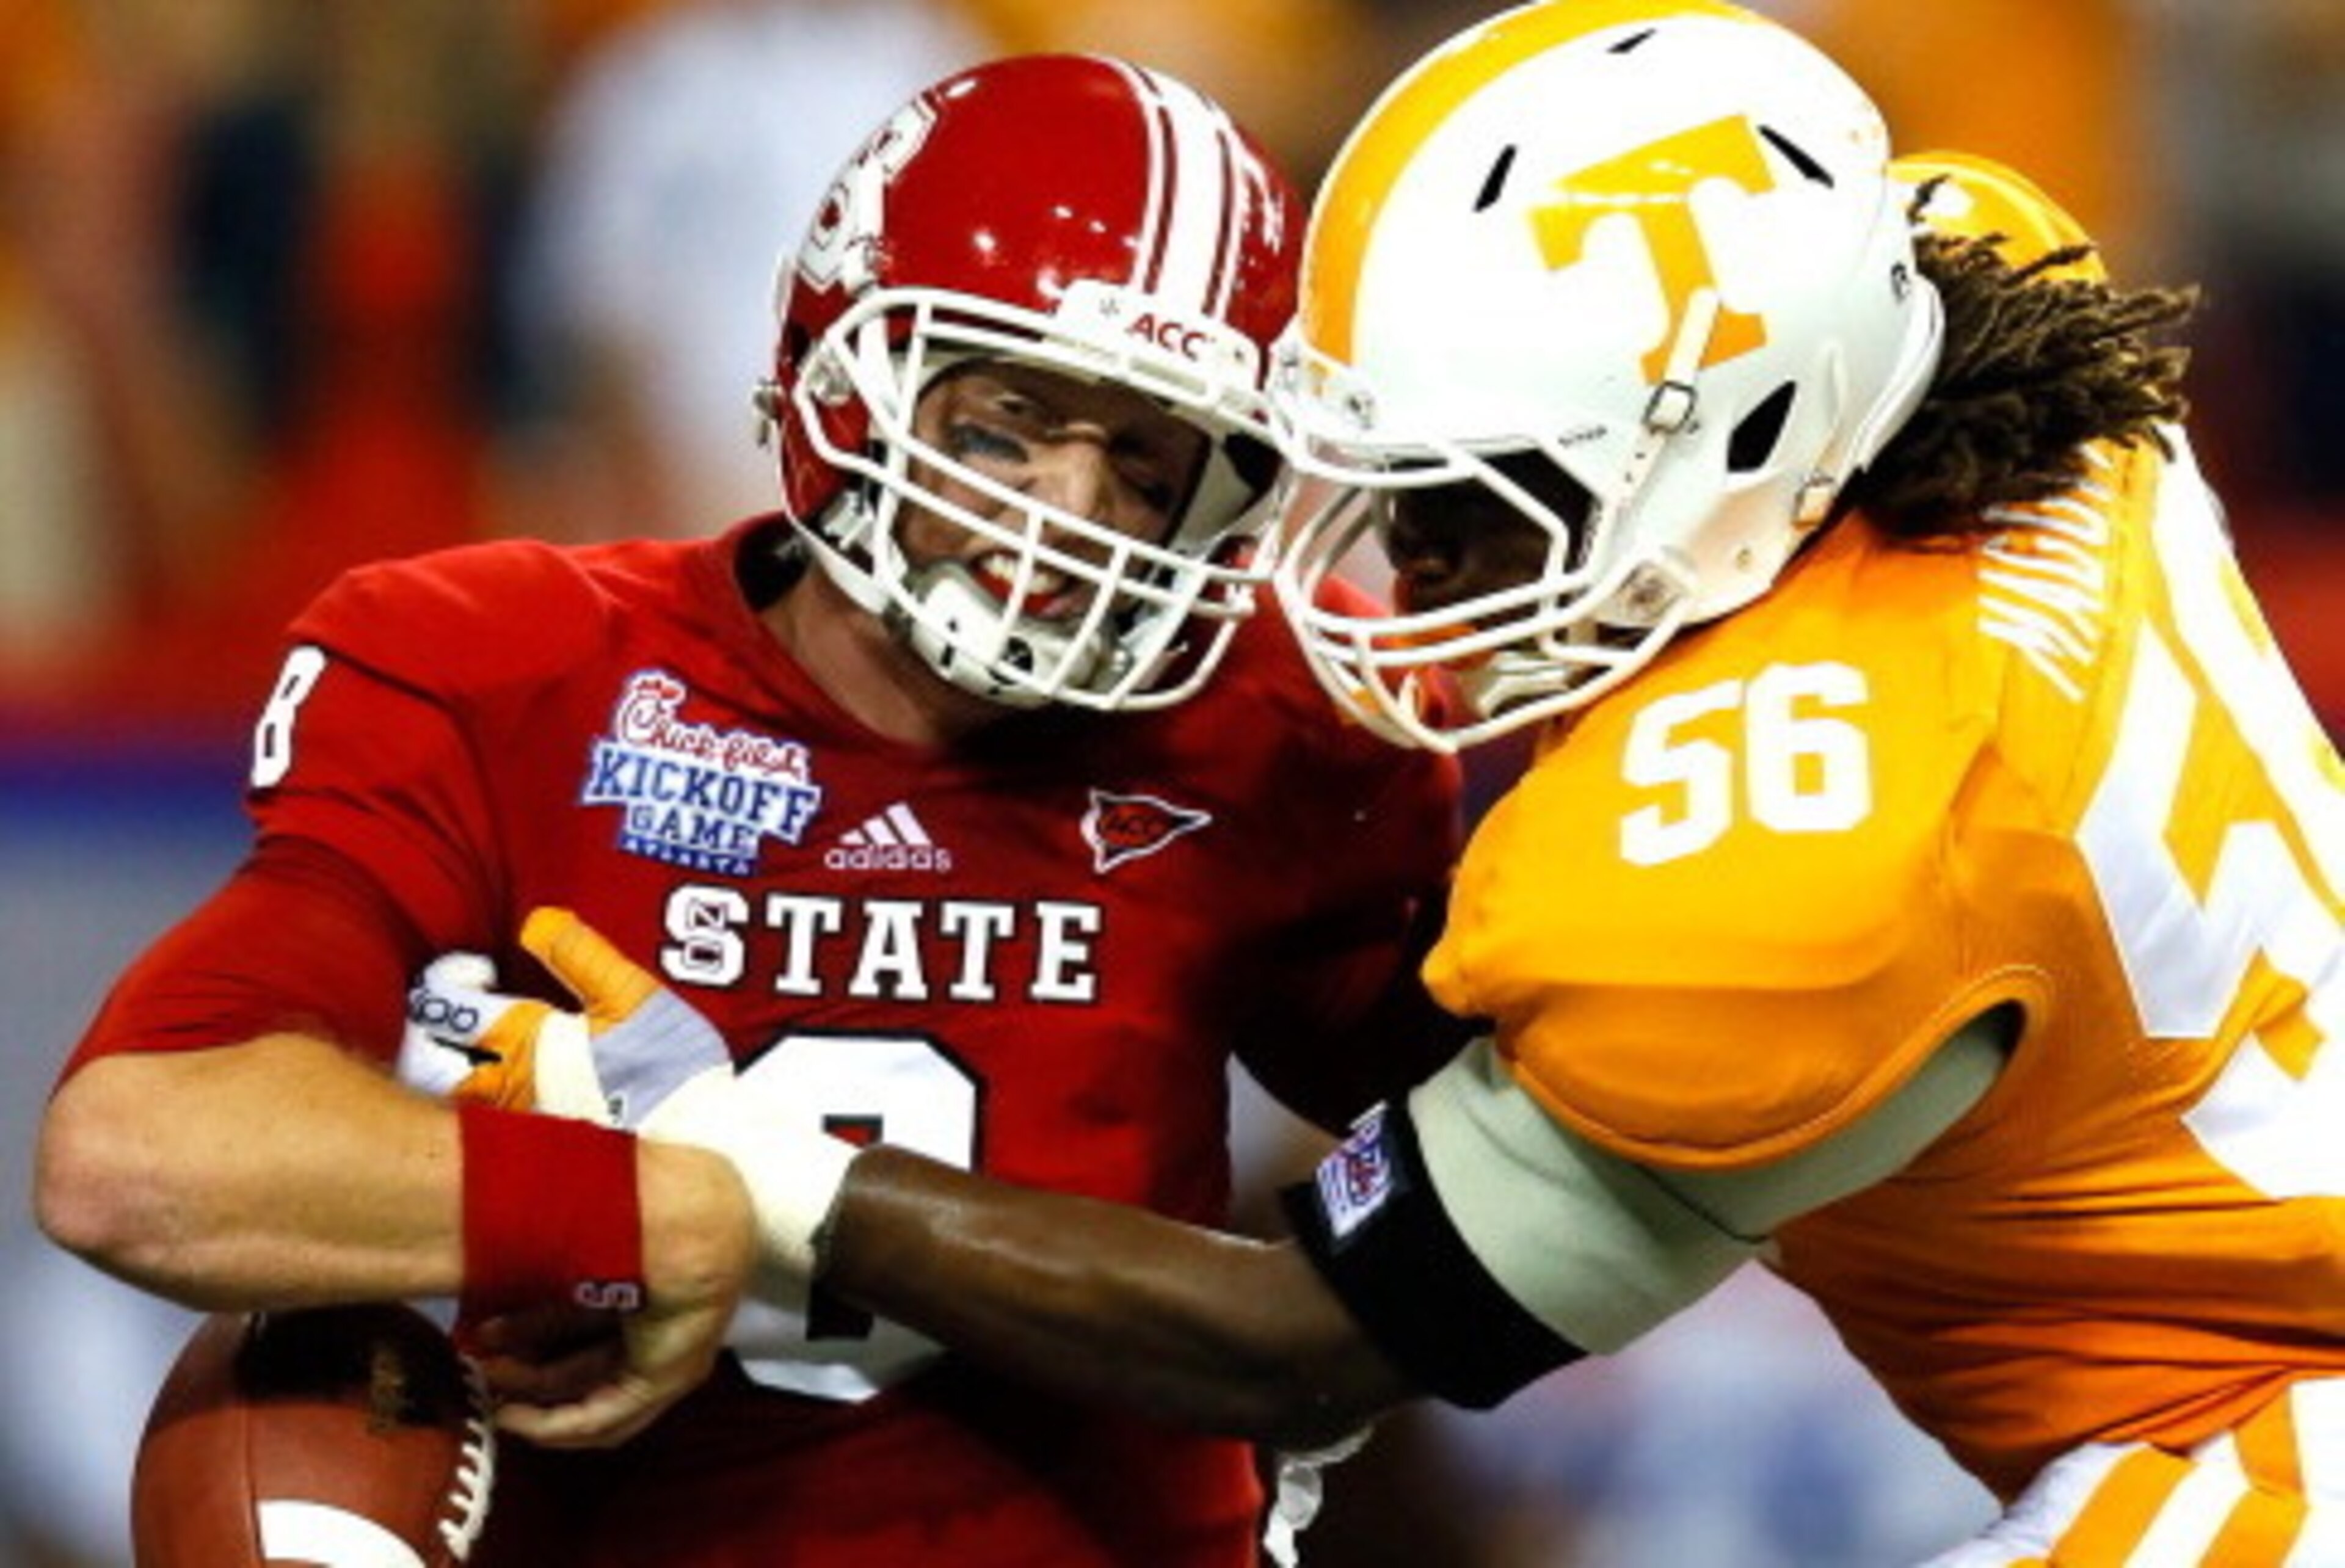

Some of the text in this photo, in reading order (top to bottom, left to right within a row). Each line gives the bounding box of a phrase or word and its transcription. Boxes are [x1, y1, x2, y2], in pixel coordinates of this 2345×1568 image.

[1125, 313, 1206, 361] ACC
[252, 646, 325, 788] 8
[594, 748, 817, 833] KICKOFF
[1620, 661, 1874, 867] 56
[632, 805, 756, 852] GAME
[824, 845, 953, 872] adidas
[661, 884, 1100, 1001] STATE
